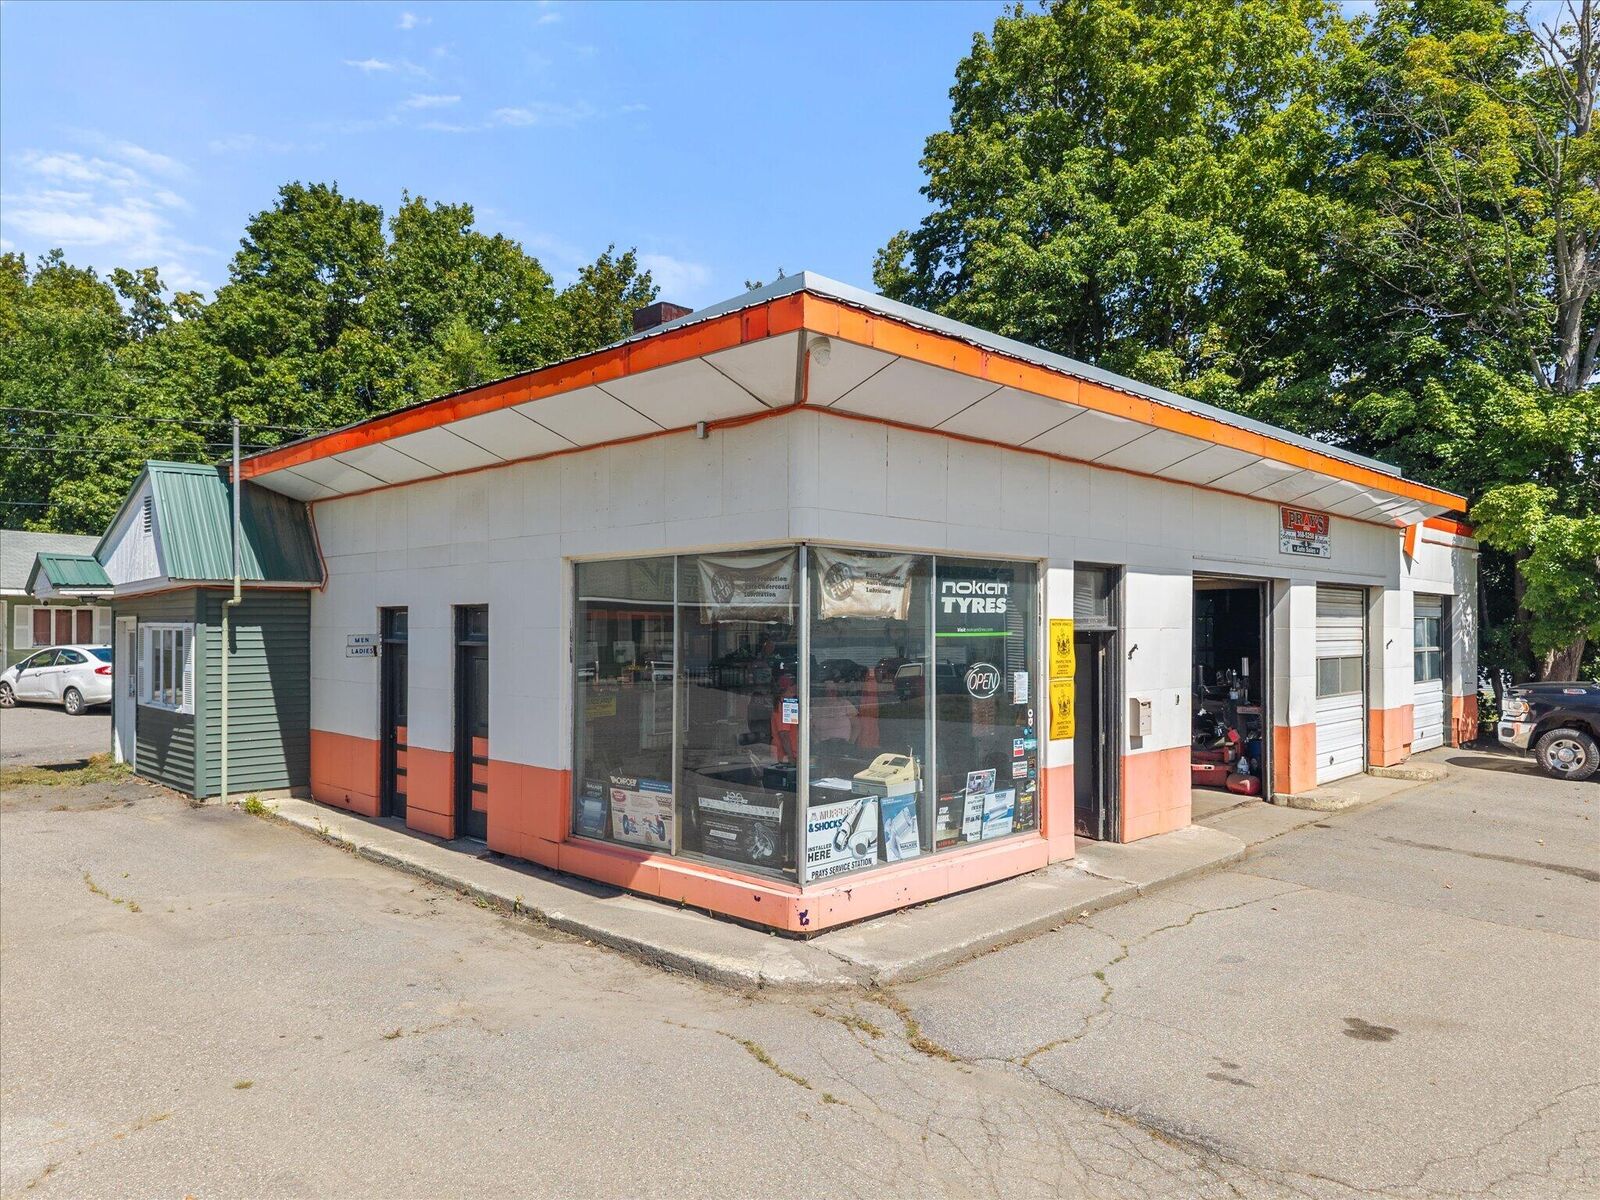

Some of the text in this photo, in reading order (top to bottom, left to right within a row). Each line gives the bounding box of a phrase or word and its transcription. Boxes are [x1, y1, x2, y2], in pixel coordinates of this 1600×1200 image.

[941, 597, 1007, 613] TYRES
[970, 673, 997, 690] OPEN
[808, 843, 832, 852] INSTALLED
[808, 849, 831, 862] HERE
[811, 858, 873, 880] PRAYS SERVICE STATION
